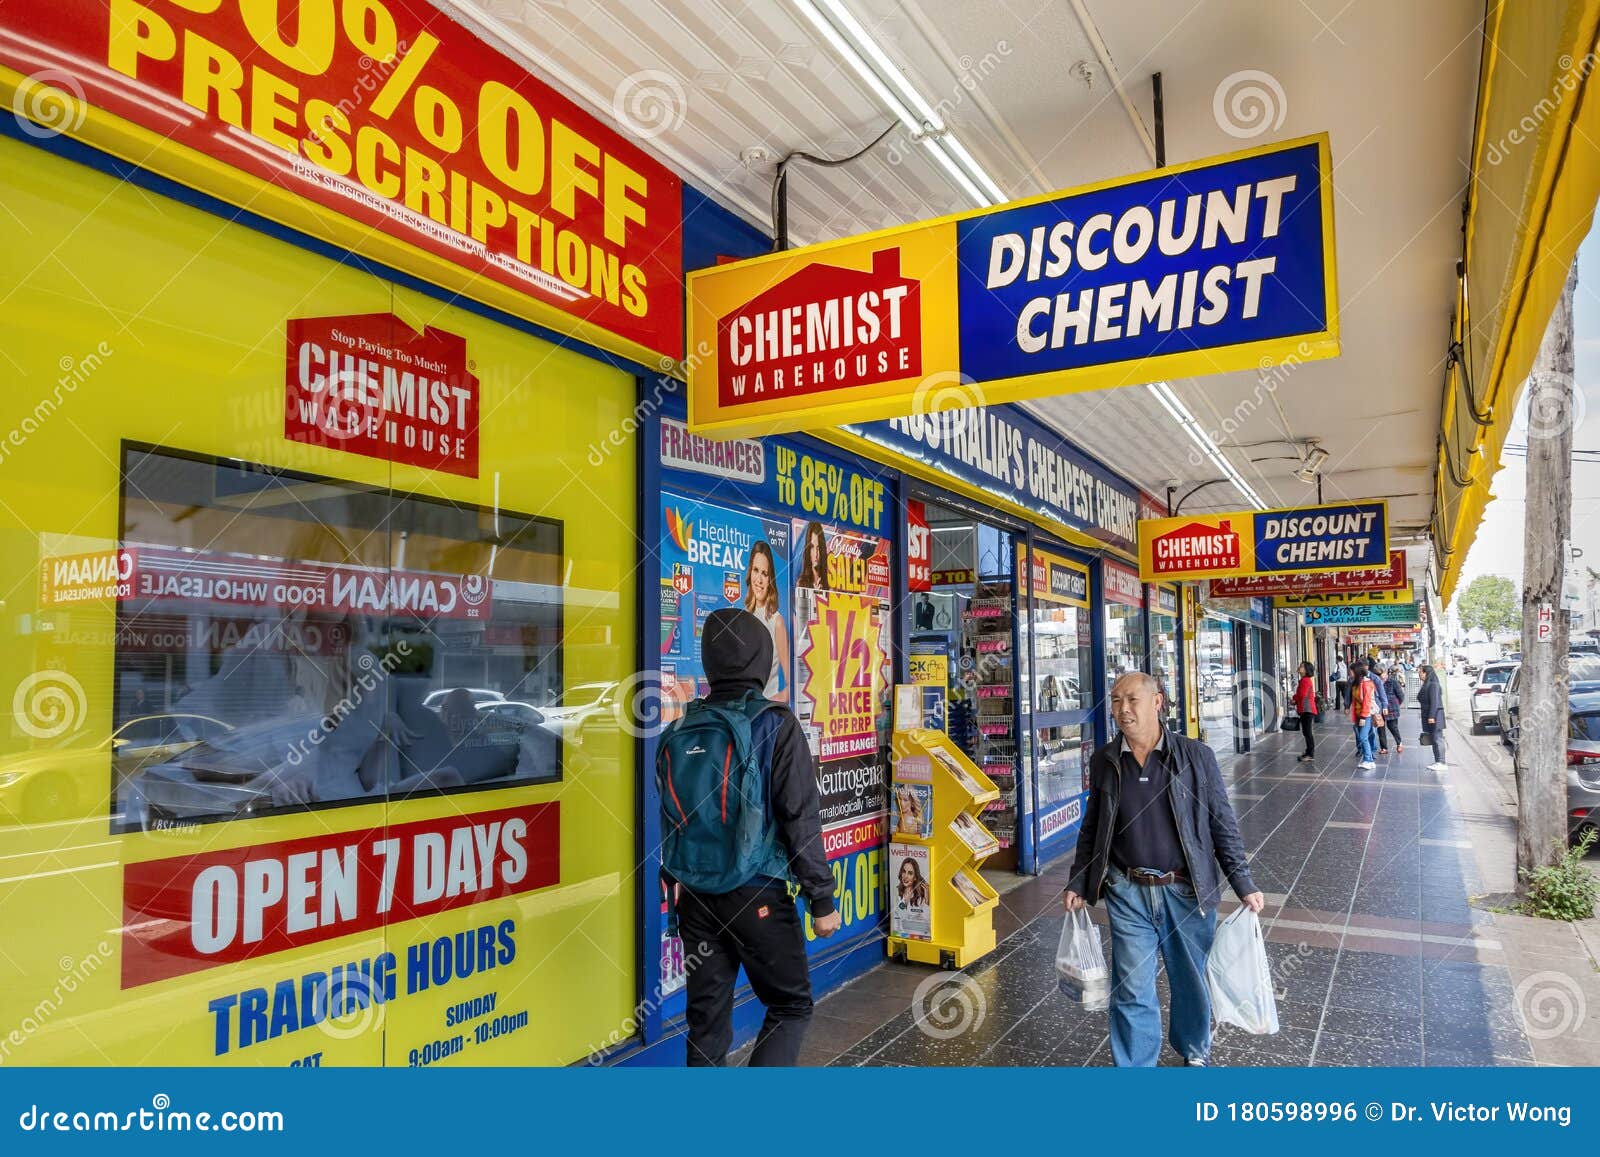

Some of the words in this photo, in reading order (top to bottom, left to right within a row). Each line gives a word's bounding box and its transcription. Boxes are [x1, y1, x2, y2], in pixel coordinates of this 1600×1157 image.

[180, 0, 463, 152] 0%
[477, 80, 648, 248] OFF
[107, 10, 649, 317] PRESCRIPTIONS
[323, 176, 388, 216] SUBSIDISED
[987, 174, 1296, 288] DISCOUNT
[1015, 257, 1276, 354] CHEMIST
[729, 285, 908, 367] CHEMIST
[331, 328, 355, 348] Stop
[358, 333, 394, 362] Paying
[395, 347, 413, 365] Too
[413, 355, 448, 376] Much!!
[731, 348, 910, 396] WAREHOUSE
[298, 341, 471, 431] CHEMIST
[298, 398, 466, 460] WAREHOUSE
[661, 422, 762, 476] FRAGRANCES
[776, 446, 796, 474] UP
[776, 474, 795, 506] TO
[800, 455, 847, 522] 85%
[850, 473, 884, 529] OFF
[1027, 437, 1094, 523] CHEAPEST
[1096, 479, 1137, 544] CHEMIST
[699, 519, 750, 552] Healthy
[777, 538, 785, 547] TV
[1264, 512, 1376, 540] DISCOUNT
[688, 538, 746, 571] BREAK
[1157, 534, 1235, 559] CHEMIST
[1159, 556, 1236, 570] WAREHOUSE
[1276, 538, 1370, 563] CHEMIST
[675, 562, 680, 576] 2
[675, 577, 689, 592] $14
[826, 551, 867, 593] SALE!
[826, 610, 872, 689] 1/2
[828, 691, 872, 716] PRICE
[821, 738, 849, 756] ENTIRE
[850, 735, 877, 751] RANGE!
[830, 717, 848, 735] OFF
[851, 716, 871, 734] RRP
[823, 830, 853, 853] LOGUE
[854, 824, 871, 844] OUT
[891, 844, 927, 858] wellness
[191, 843, 359, 955] OPEN
[373, 841, 400, 914] 7
[412, 819, 529, 904] DAYS
[209, 952, 397, 1057] TRADING
[407, 920, 517, 995] HOURS
[446, 992, 498, 1028] SUNDAY
[408, 1033, 464, 1067] 9:00am
[474, 1010, 529, 1045] 10:00pm
